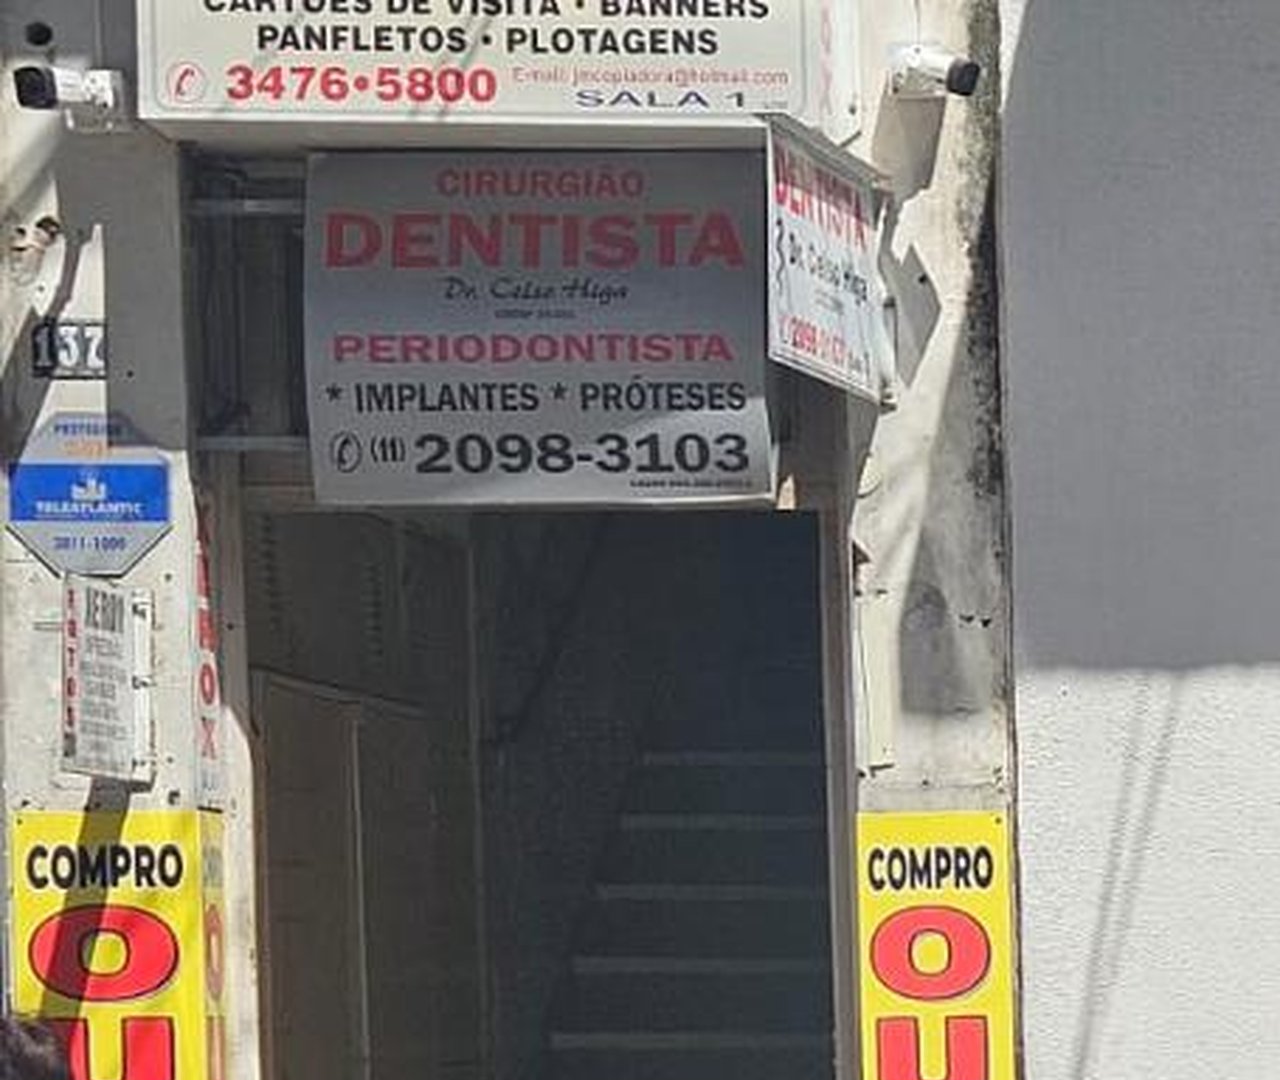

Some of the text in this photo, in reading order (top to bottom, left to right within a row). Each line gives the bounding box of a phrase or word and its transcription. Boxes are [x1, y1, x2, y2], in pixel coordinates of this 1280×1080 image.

[257, 25, 718, 55] PANFLETOS PLOTAGENS
[575, 89, 710, 108] SALA
[725, 91, 744, 108] 1
[437, 166, 645, 198] CIRURGIÃO
[323, 212, 746, 270] DENTISTA
[444, 277, 629, 304] Dr. Celso Higa
[332, 332, 734, 363] PERIODONTISTA
[356, 374, 747, 412] IMPLANTES PRÓTESES
[370, 432, 750, 475] (11) 2098-3103
[26, 844, 183, 889] COMPRO
[867, 847, 994, 891] COMPRO
